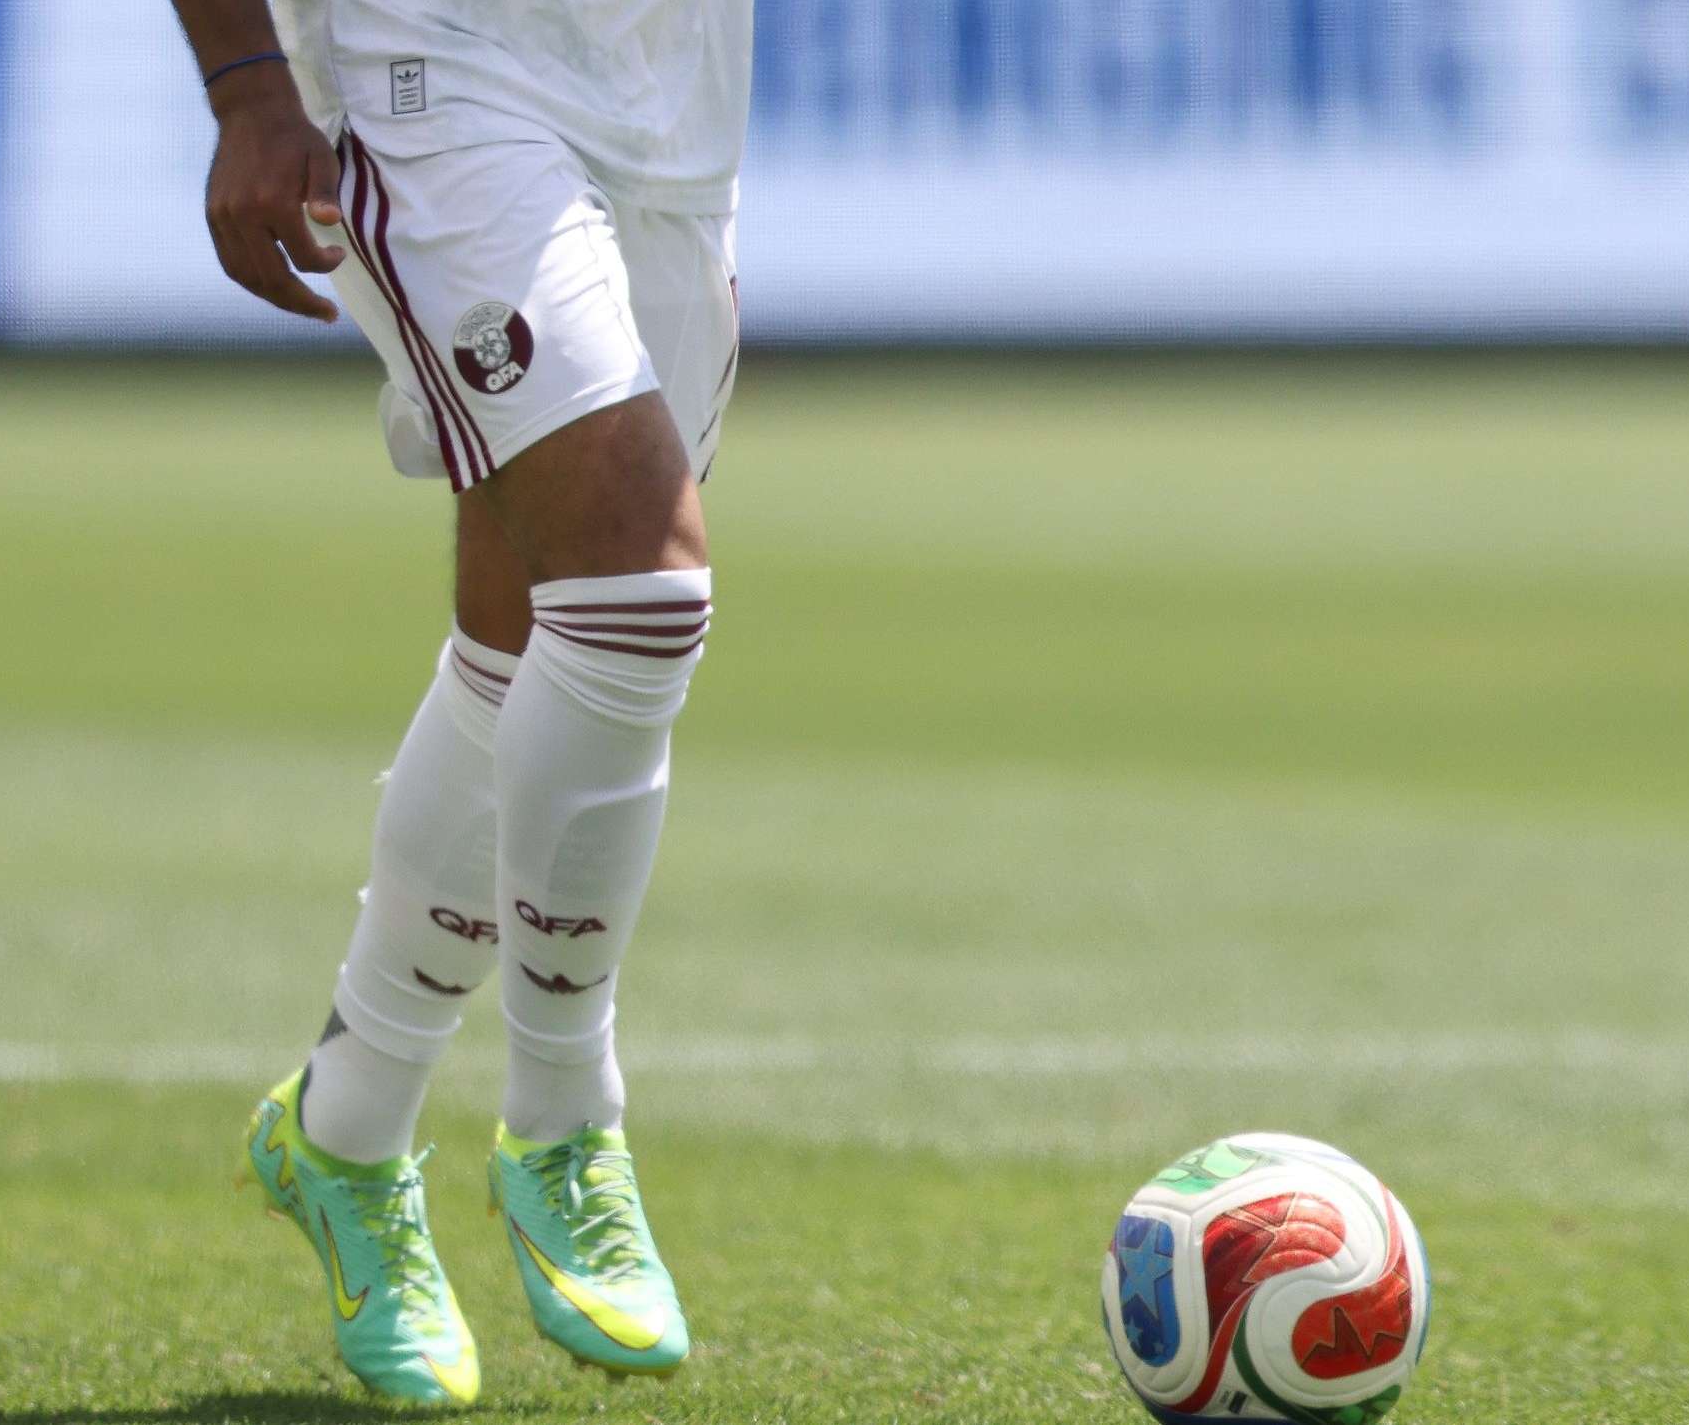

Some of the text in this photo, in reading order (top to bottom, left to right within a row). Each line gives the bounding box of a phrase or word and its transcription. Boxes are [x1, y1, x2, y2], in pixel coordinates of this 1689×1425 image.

[485, 361, 524, 391] QFA
[429, 907, 499, 945] QF
[515, 899, 608, 939] QFA
